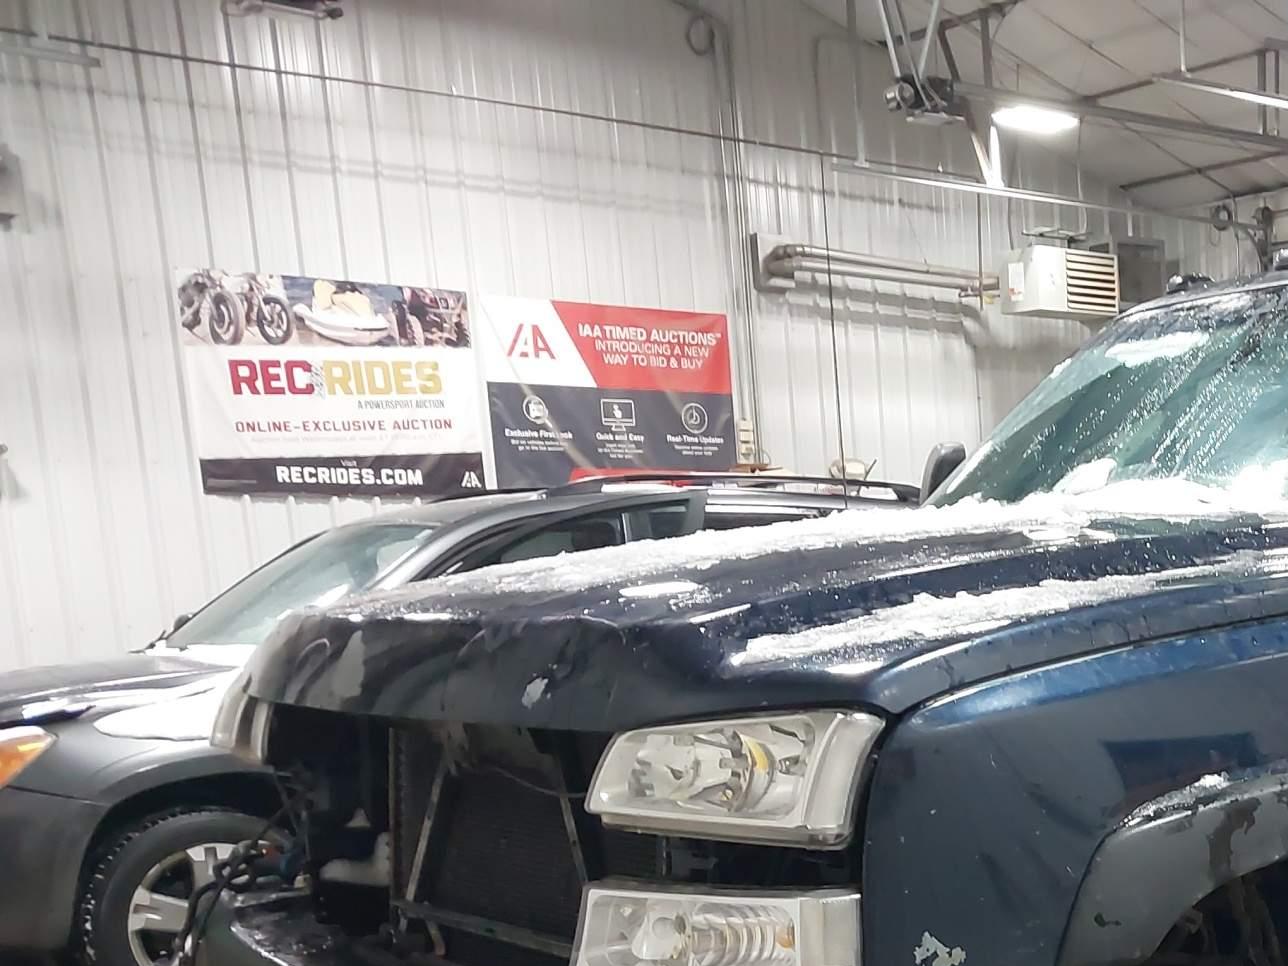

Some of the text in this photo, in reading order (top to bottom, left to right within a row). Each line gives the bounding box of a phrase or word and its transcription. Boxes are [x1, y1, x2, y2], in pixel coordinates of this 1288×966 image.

[578, 323, 602, 338] IAA
[603, 325, 647, 341] TIMED
[595, 340, 709, 358] INTRODUCING A NEW
[602, 353, 703, 369] WAY TO BID & BUY
[235, 419, 453, 432] ONLINE-EXCLUSIVE AUCTION
[276, 466, 423, 486] RECRIDES.COM
